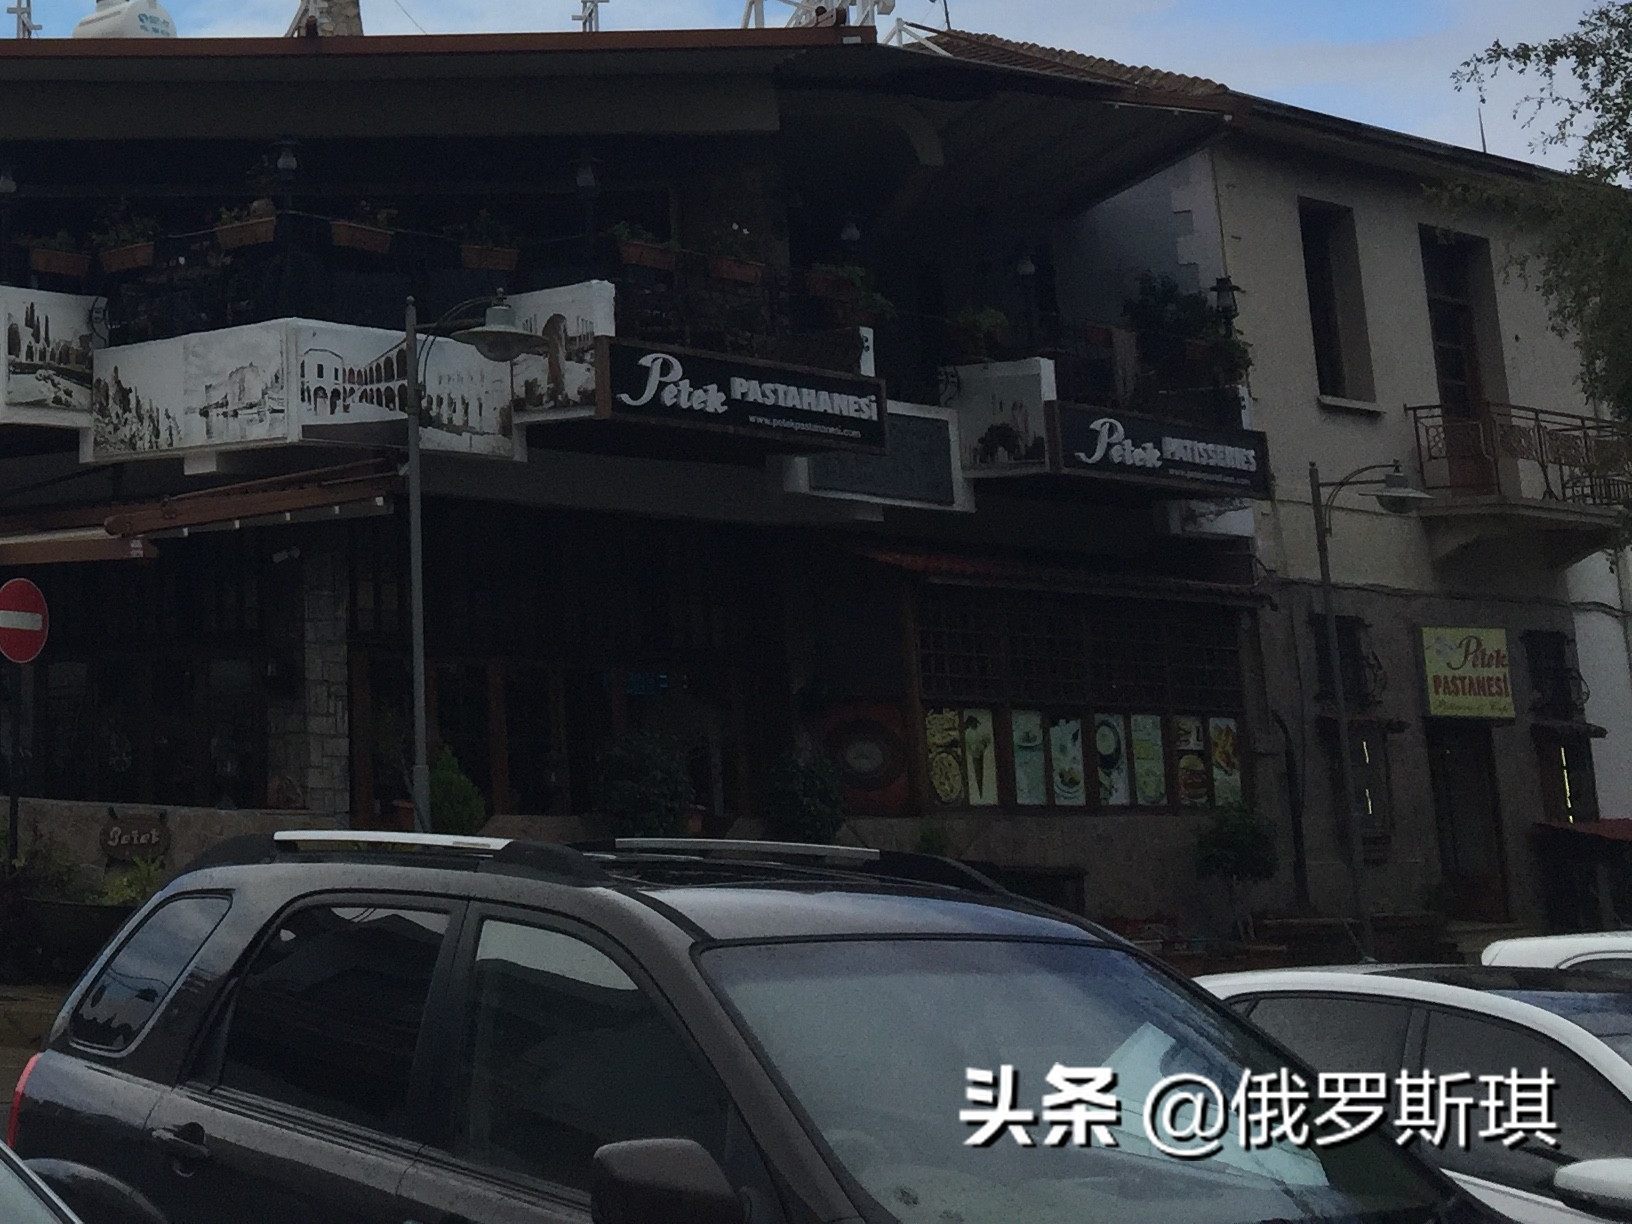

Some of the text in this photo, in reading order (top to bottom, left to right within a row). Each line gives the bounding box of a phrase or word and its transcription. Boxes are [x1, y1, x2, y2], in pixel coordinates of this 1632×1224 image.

[617, 353, 728, 413] Petek
[1074, 417, 1163, 468] Petek
[1446, 635, 1508, 670] Petek
